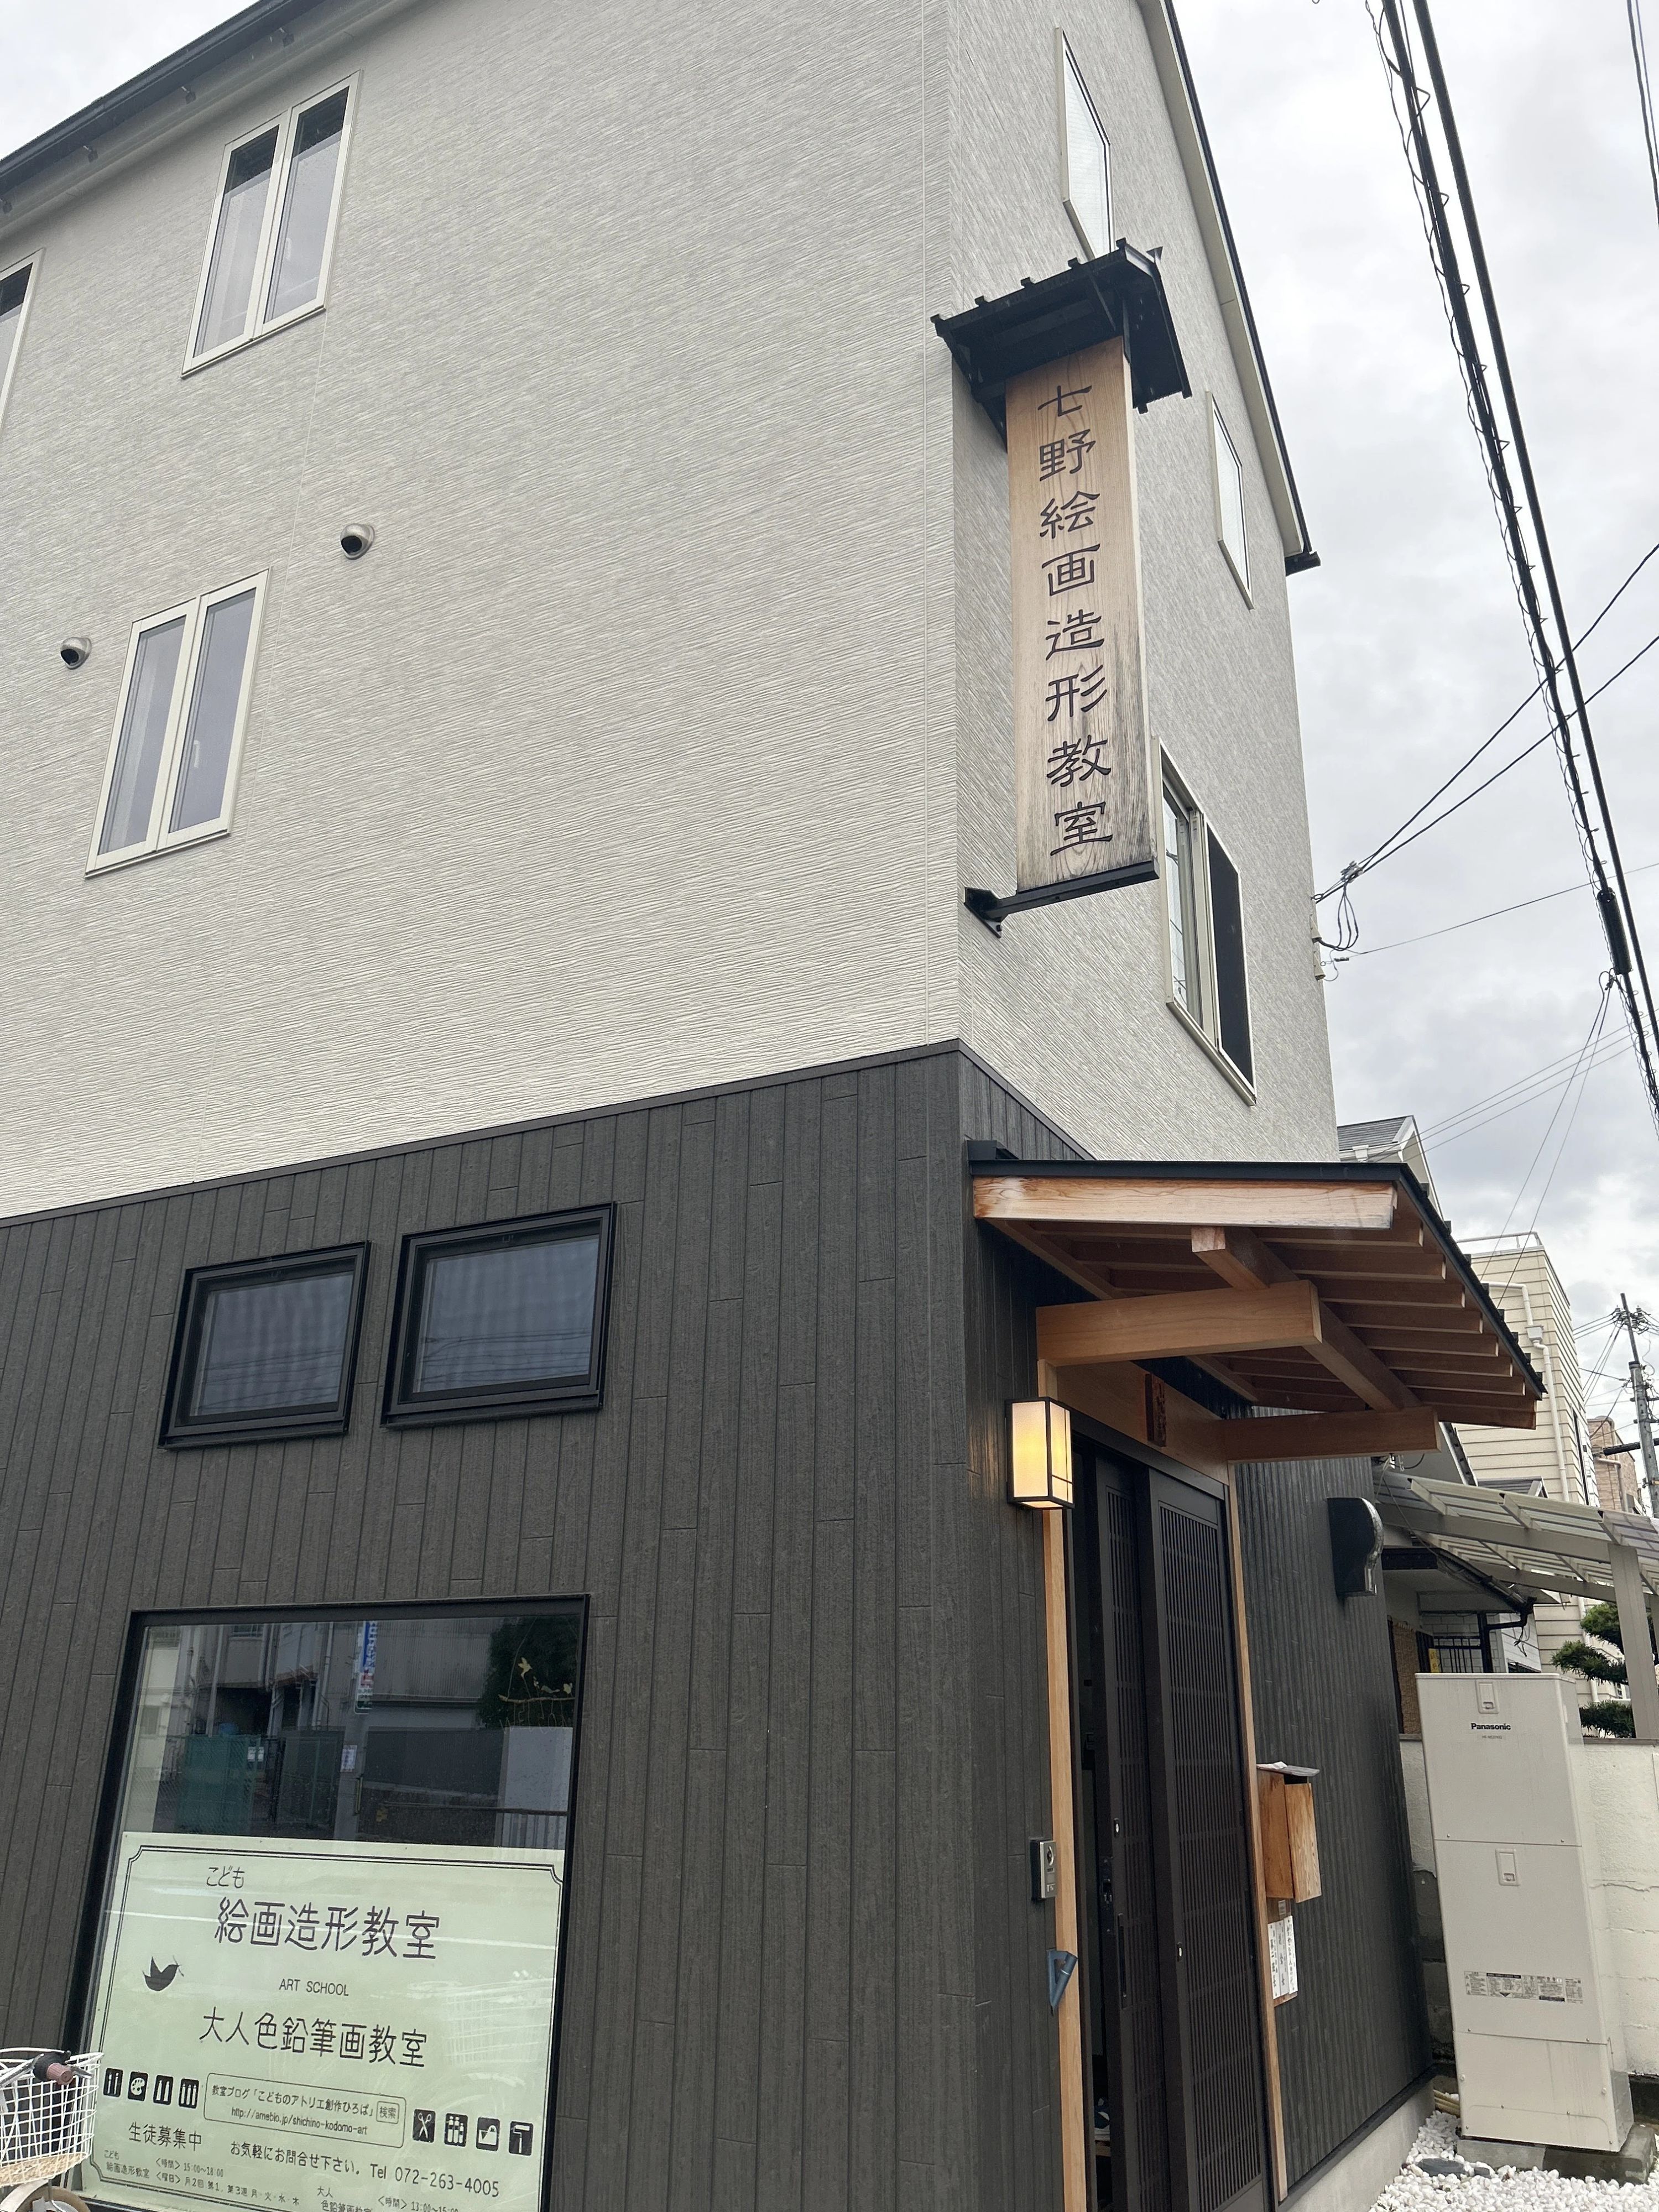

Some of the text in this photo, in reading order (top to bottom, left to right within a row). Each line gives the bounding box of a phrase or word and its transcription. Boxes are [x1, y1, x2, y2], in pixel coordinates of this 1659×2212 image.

[1037, 385, 1113, 856] 七野絵画造形教室
[206, 1866, 245, 1889] こども
[215, 1896, 440, 1960] 絵画造形教室
[279, 1979, 349, 1996] ART SCHOOL
[199, 2006, 427, 2068] 大人色鉛筆画教室
[379, 2106, 397, 2120] 検索
[128, 2121, 202, 2151] 生徒募集中
[104, 2150, 119, 2160] こども
[231, 2141, 499, 2198] お気軽にお問合せ下さい。 Tel 072-263-4005
[317, 2186, 333, 2198] 大人
